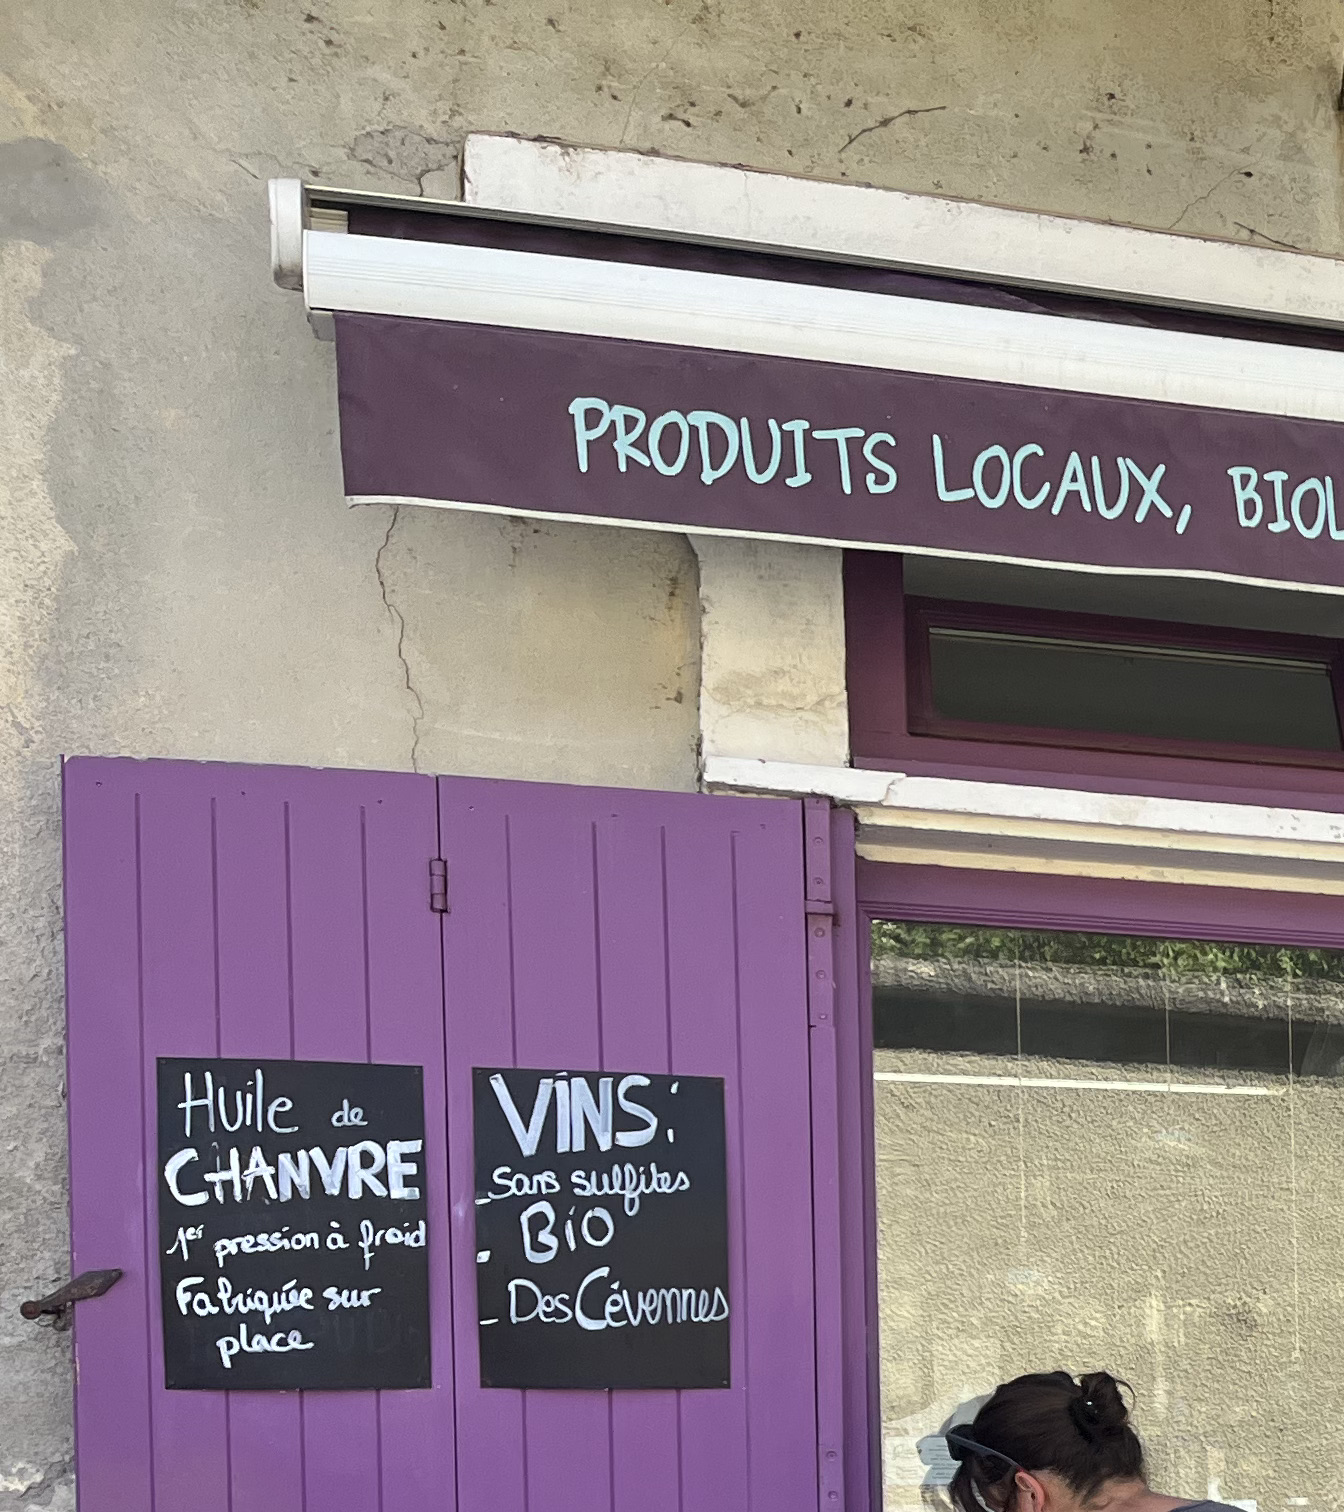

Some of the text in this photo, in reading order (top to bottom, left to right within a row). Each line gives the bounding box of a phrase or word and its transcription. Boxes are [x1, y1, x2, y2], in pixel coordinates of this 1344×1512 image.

[568, 396, 899, 495] PRODUITS
[932, 434, 1193, 535] LOCAUX,
[177, 1067, 369, 1138] Huile de
[163, 1138, 423, 1206] CHANVRE
[487, 1162, 691, 1217] Sans sulfites
[212, 1225, 320, 1268] pression
[326, 1220, 350, 1250] à
[358, 1218, 427, 1271] froid
[322, 1286, 382, 1311] sur
[507, 1266, 730, 1331] Des Cévennes
[215, 1322, 315, 1369] place
